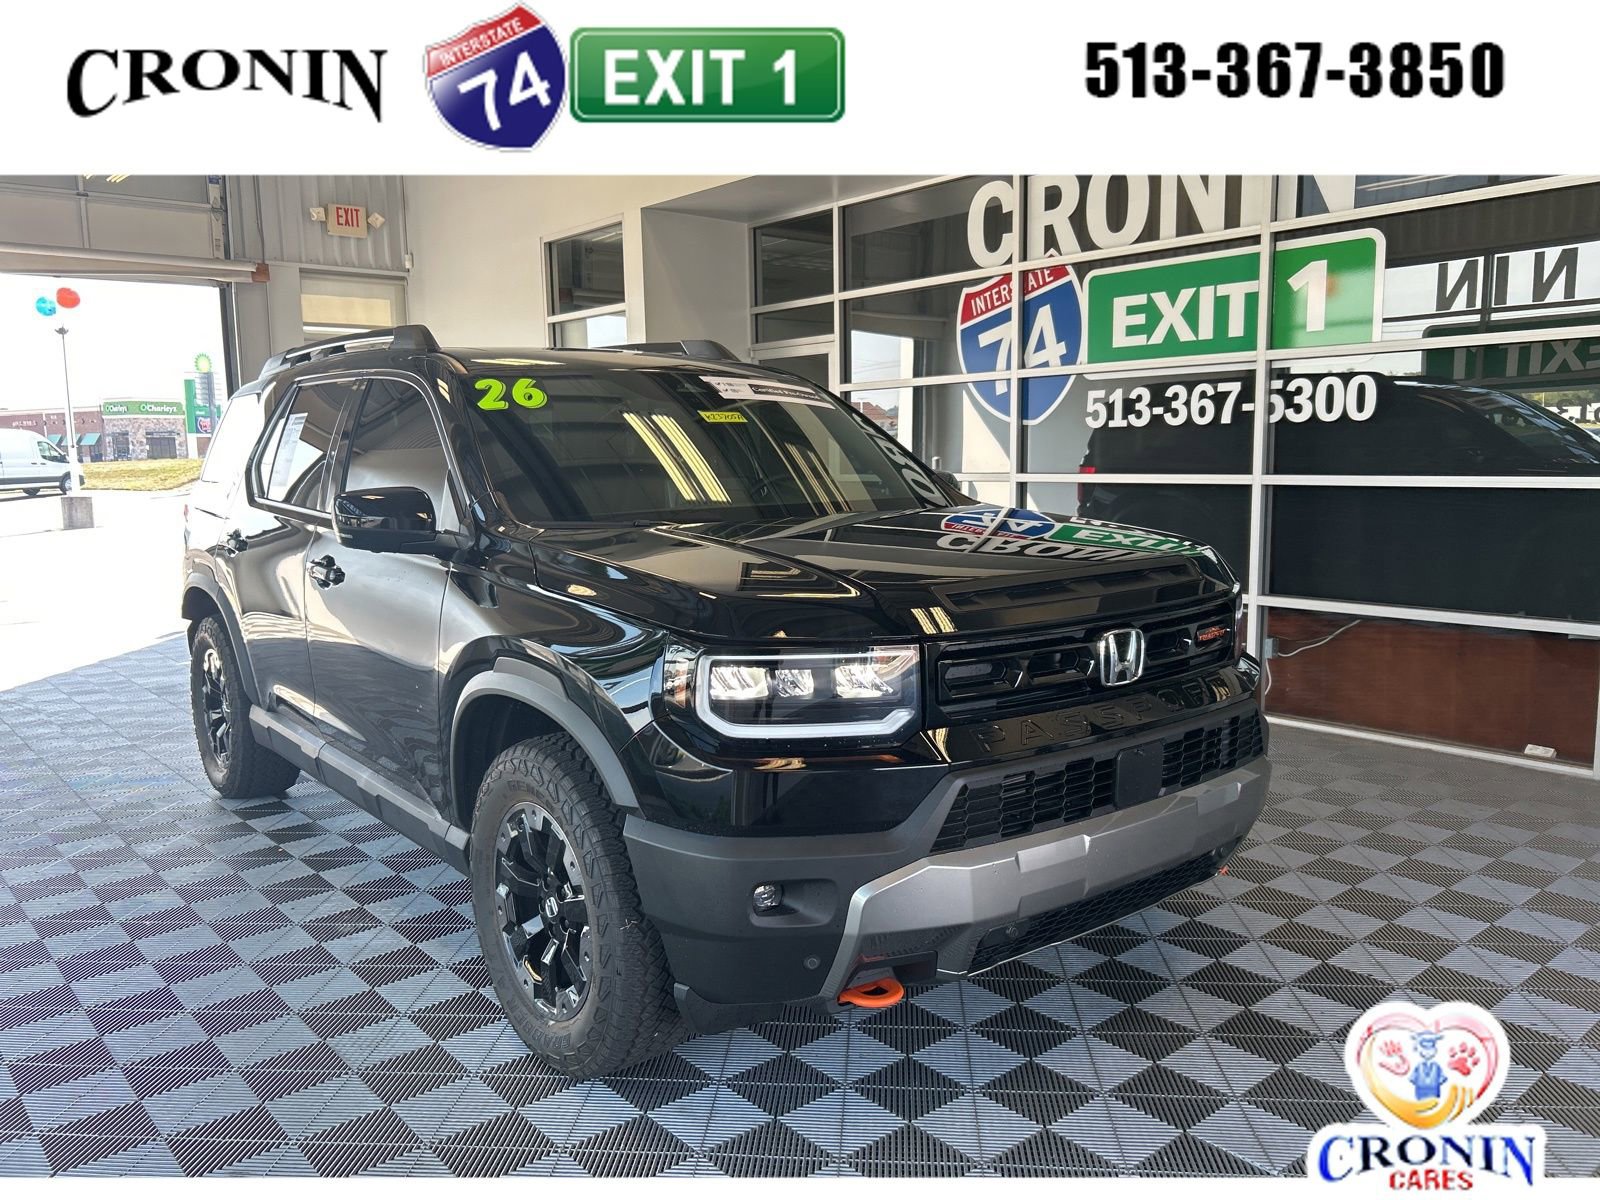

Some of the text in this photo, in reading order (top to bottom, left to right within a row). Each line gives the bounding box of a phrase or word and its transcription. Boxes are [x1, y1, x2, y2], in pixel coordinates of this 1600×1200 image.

[335, 206, 360, 228] EXIT
[971, 268, 1055, 317] INTERATE
[1112, 259, 1328, 349] EXIT 1
[977, 303, 1067, 397] 74
[474, 378, 548, 411] 26
[1085, 374, 1377, 429] 513-367-5300
